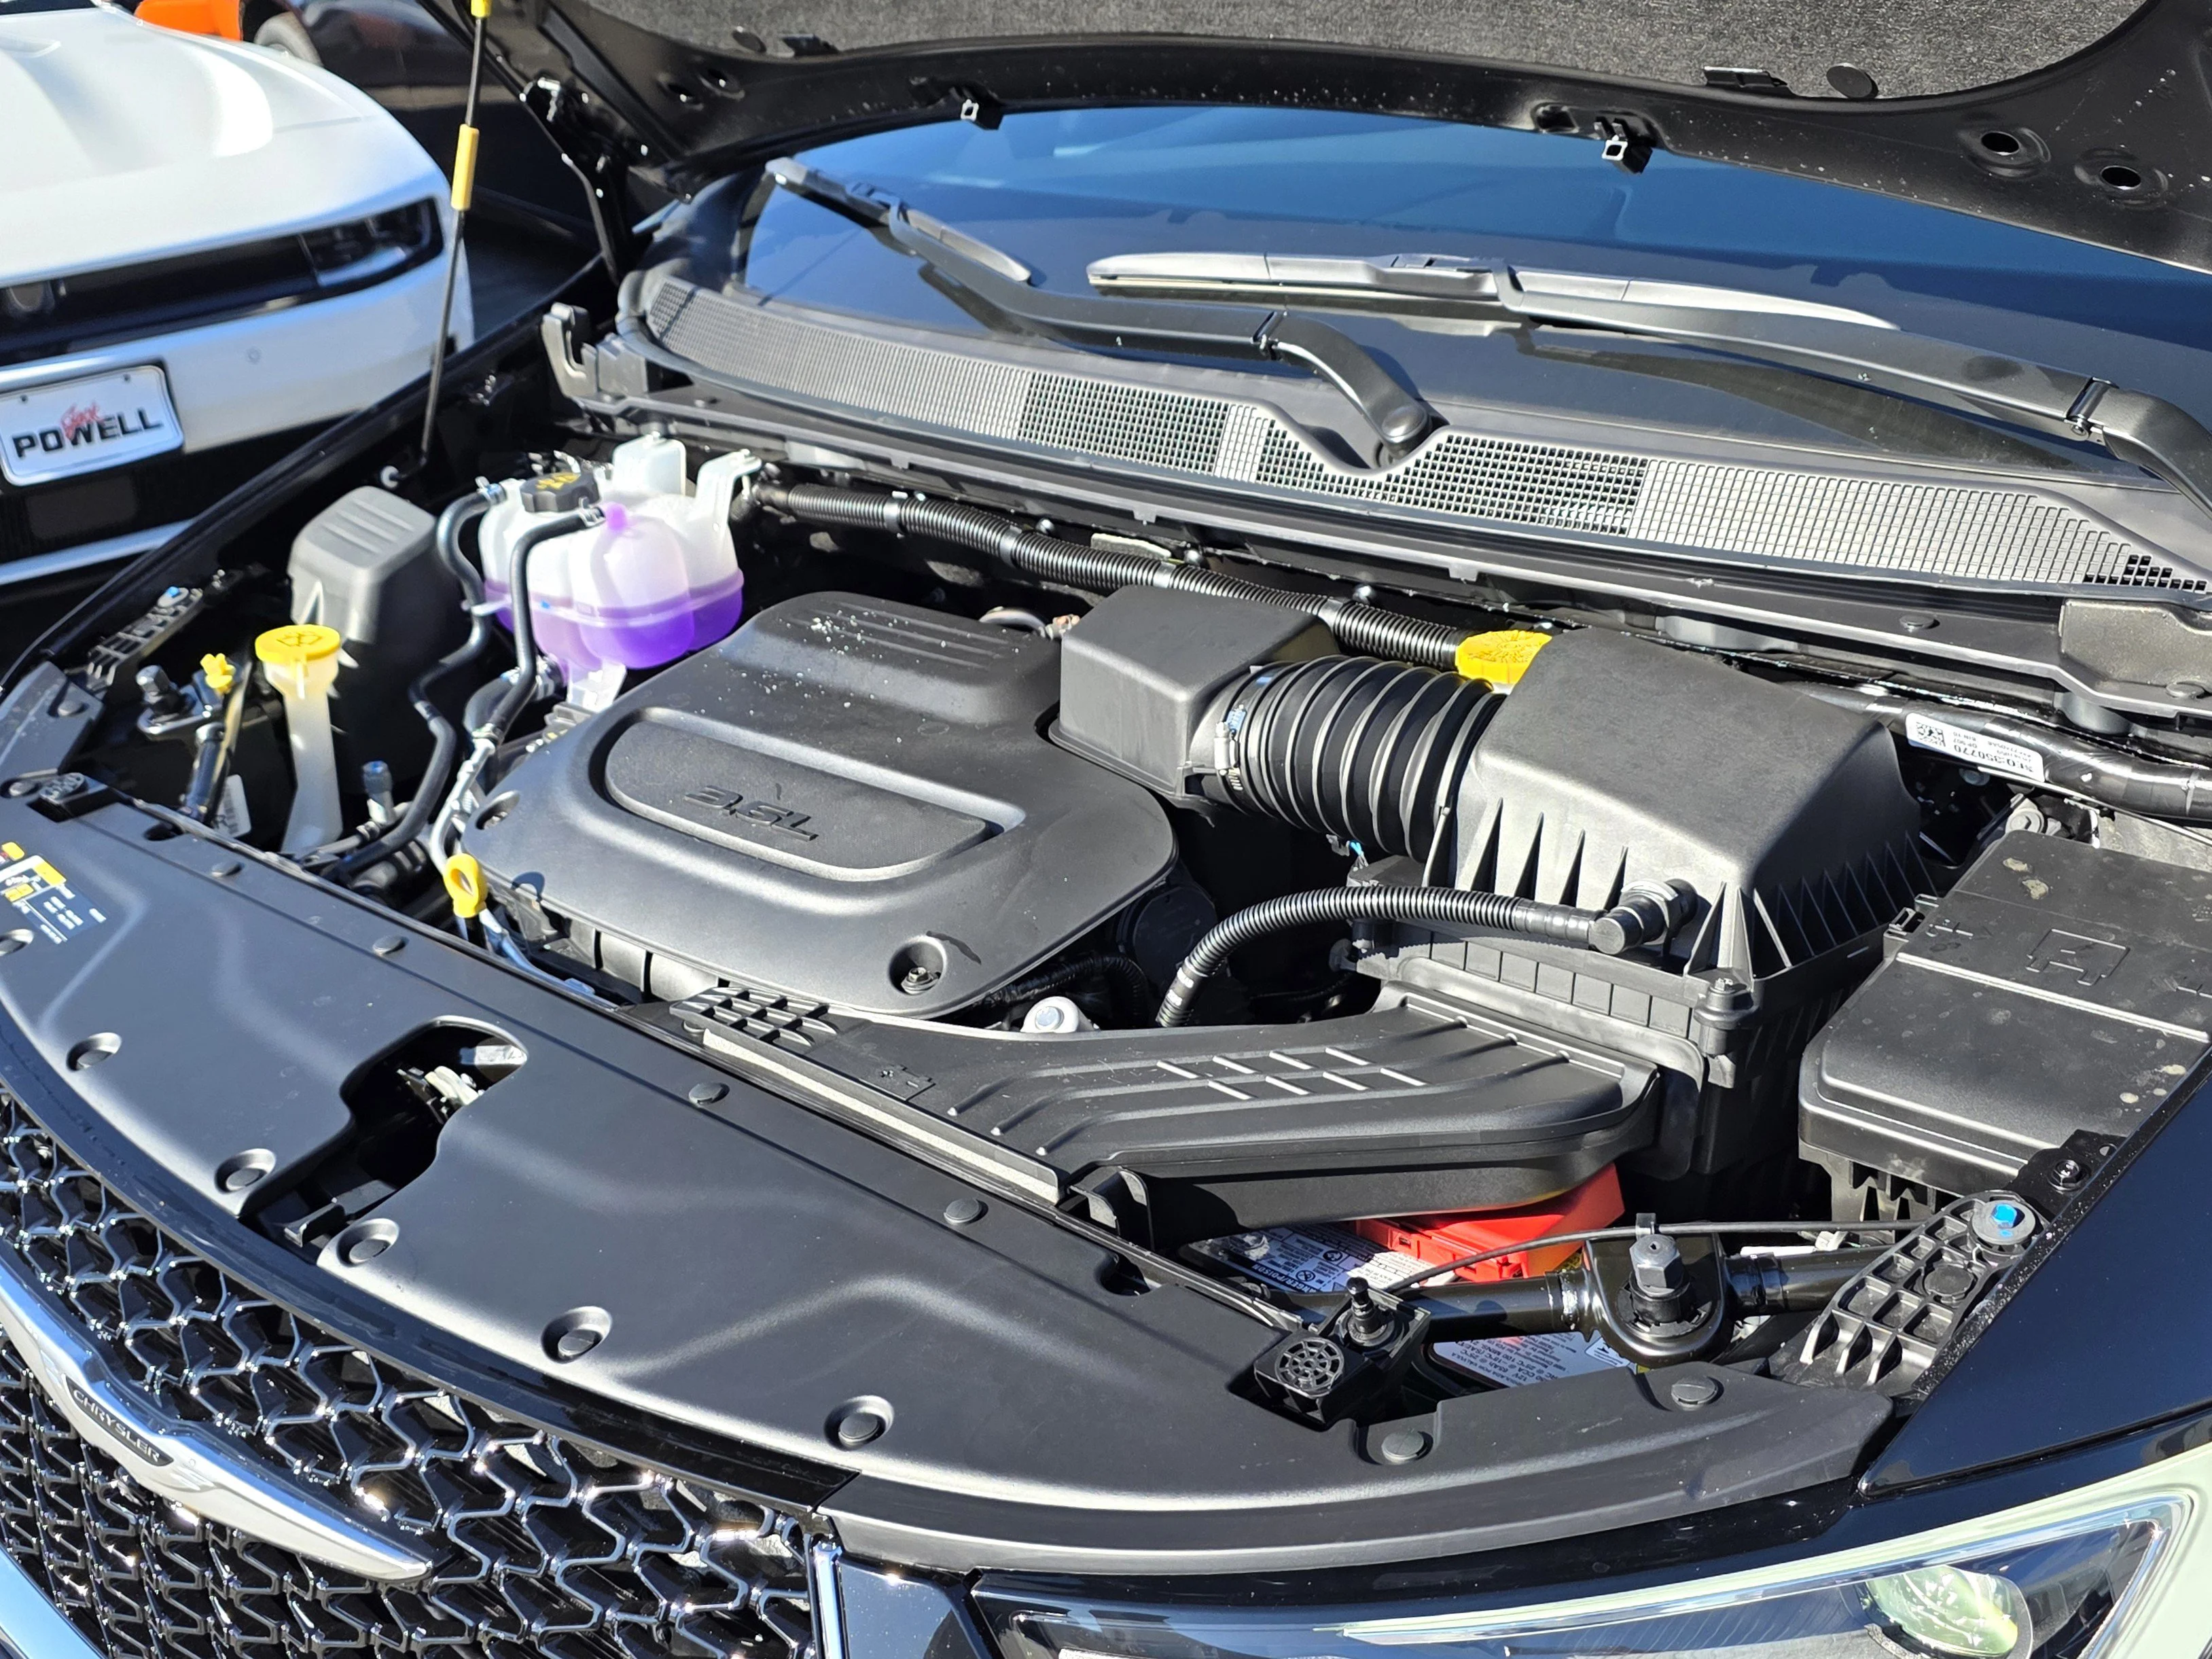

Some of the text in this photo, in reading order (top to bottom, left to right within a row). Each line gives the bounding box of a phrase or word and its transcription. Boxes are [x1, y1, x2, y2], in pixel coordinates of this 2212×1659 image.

[12, 408, 163, 458] POWELL
[683, 785, 819, 842] 3.6L
[73, 1389, 160, 1462] CHRYSLER
